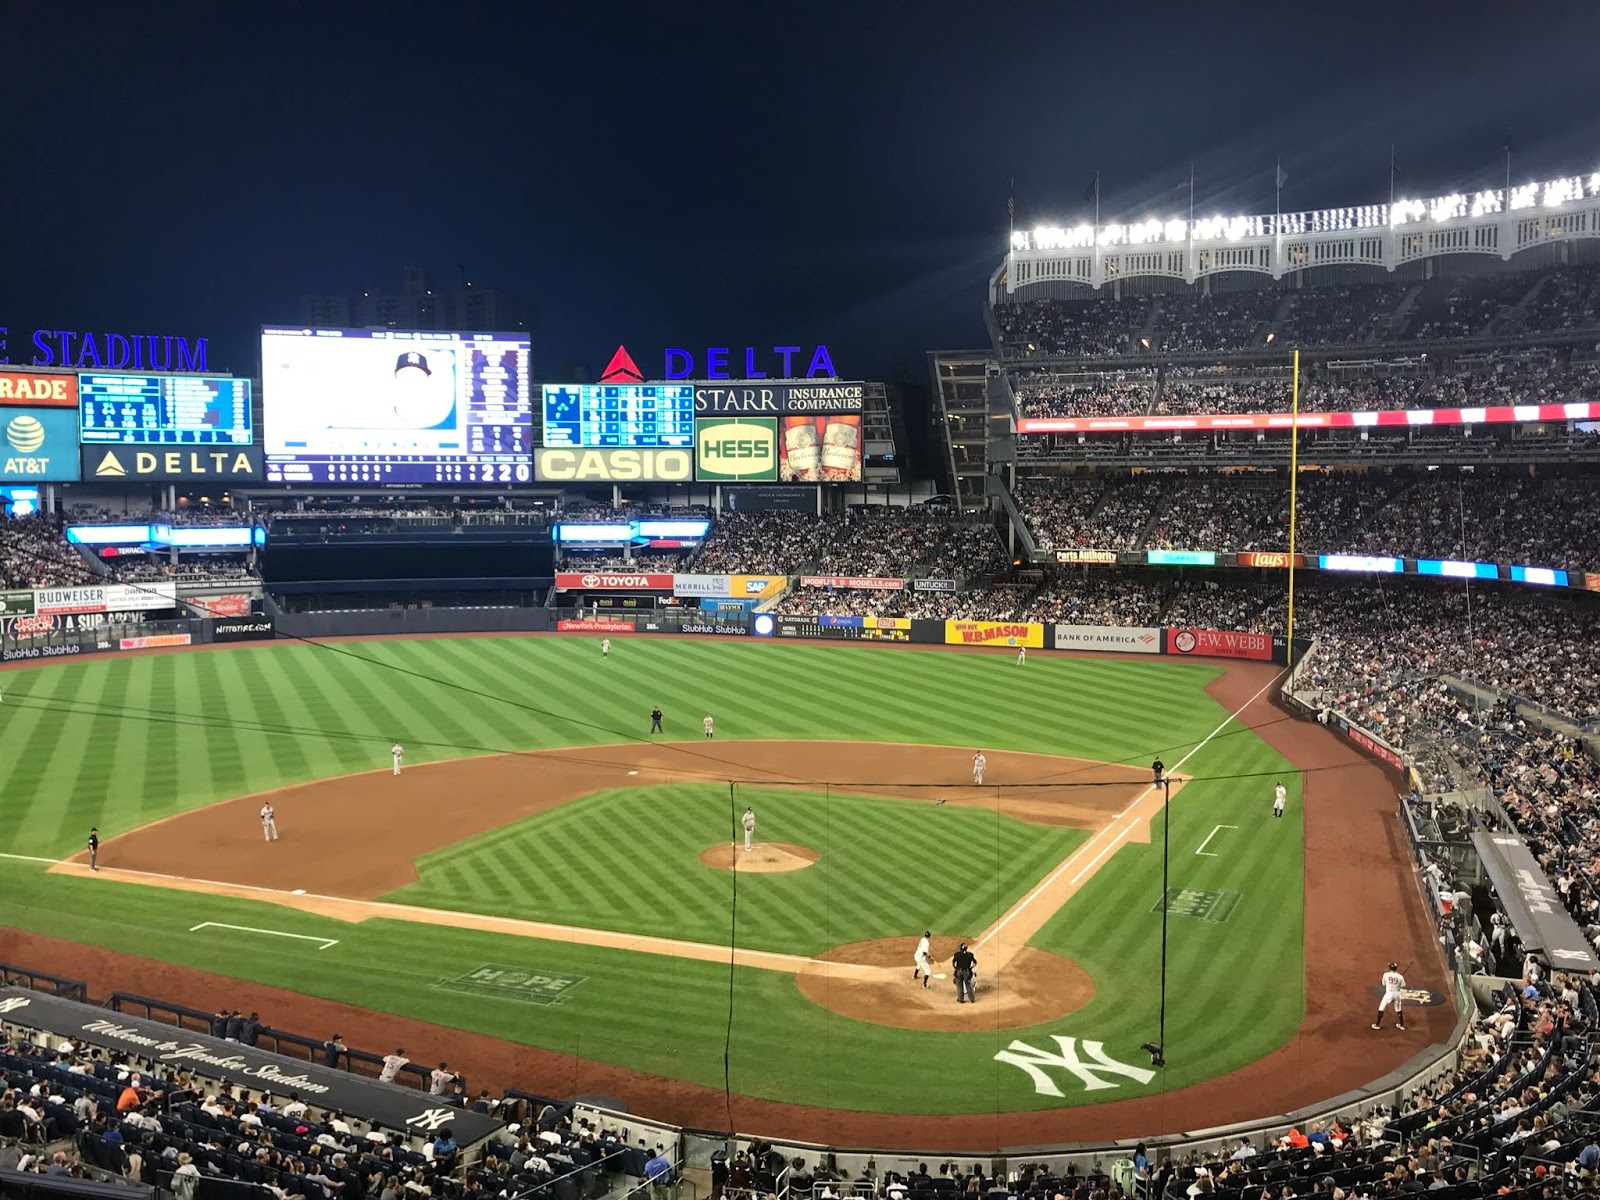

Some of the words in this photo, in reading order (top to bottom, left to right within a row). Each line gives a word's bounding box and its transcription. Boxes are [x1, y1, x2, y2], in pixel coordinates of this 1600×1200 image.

[33, 329, 208, 372] STADIUM
[665, 345, 836, 380] DELTA
[788, 386, 862, 399] INSURANCE
[695, 389, 779, 412] STARR
[788, 398, 862, 411] COMPANIES
[704, 439, 769, 458] HESS
[4, 458, 49, 474] AT&T
[136, 452, 253, 474] DELTA
[540, 450, 690, 480] CASIO
[482, 464, 494, 481] 2
[499, 464, 512, 481] 2
[1057, 551, 1078, 560] Parts
[1079, 550, 1117, 560] Authority
[601, 576, 649, 586] TOYOTA
[747, 581, 766, 592] SAP
[850, 579, 900, 587] MODELLS.com
[39, 589, 103, 604] BUDWEISER
[659, 597, 680, 605] FedEx
[682, 624, 713, 633] StubHub
[715, 626, 746, 635] StubHub
[1096, 636, 1136, 644] AMERICA
[1224, 635, 1265, 650] WEBB
[3, 648, 39, 660] StubHub
[42, 644, 79, 656] StubHub
[1388, 976, 1399, 985] 99
[159, 1043, 246, 1071] Yankee
[243, 1064, 329, 1094] Stadium
[993, 1034, 1156, 1098] NY
[406, 1108, 455, 1130] NY
